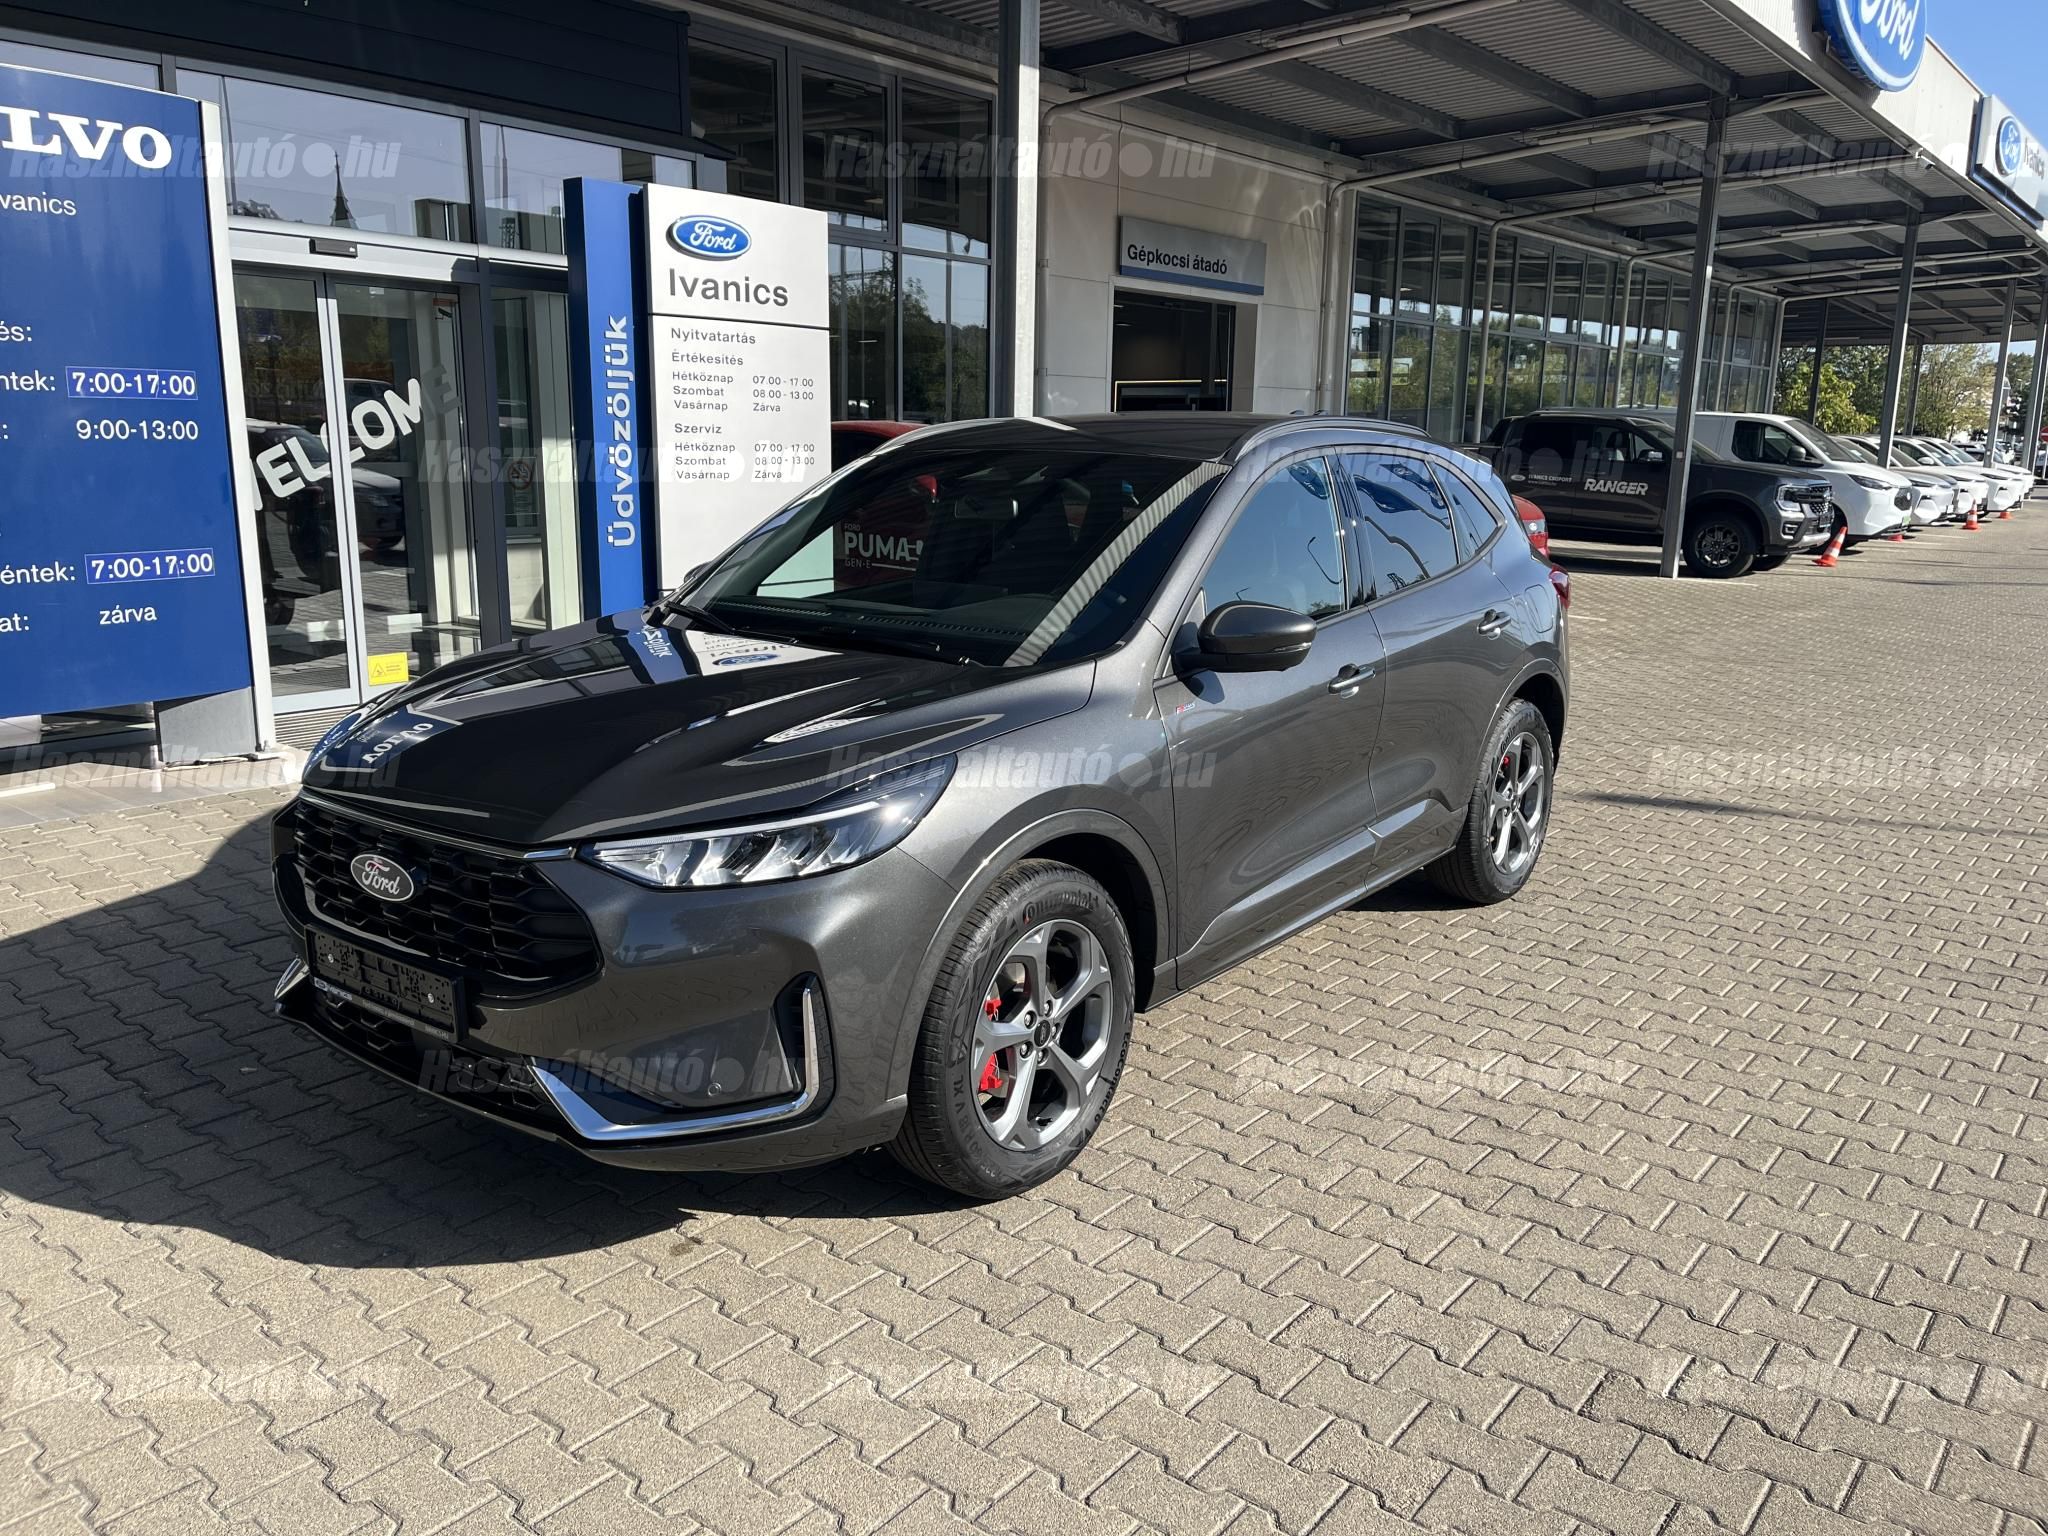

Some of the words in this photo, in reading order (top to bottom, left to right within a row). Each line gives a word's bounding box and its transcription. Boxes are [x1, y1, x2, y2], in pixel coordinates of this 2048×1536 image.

[690, 222, 736, 251] Ford
[1127, 244, 1190, 268] Gépkocsi
[1192, 254, 1228, 275] átadó
[669, 268, 789, 307] Ivanics
[671, 328, 756, 344] Nyitvatartás
[671, 349, 744, 365] Értékesítés
[71, 371, 196, 397] 7:00-17:00
[672, 371, 734, 384] Hétköznap
[673, 385, 725, 397] Szombat
[674, 399, 728, 412] Vasárnap
[753, 402, 781, 412] Zárva
[76, 419, 199, 441] 9:00-13:00
[604, 315, 636, 547] Üdvözöljük
[674, 423, 722, 434] Szerviz
[674, 441, 736, 453] Hétköznap
[675, 456, 726, 466] Szombat
[676, 470, 730, 481] Vasárnap
[754, 469, 782, 479] Zárva
[1584, 478, 1649, 496] RANGER
[844, 530, 911, 562] PUMA
[0, 560, 76, 585] éntek:
[90, 553, 214, 579] 7:00-17:00
[99, 605, 157, 625] zárva
[361, 858, 400, 895] Ford
